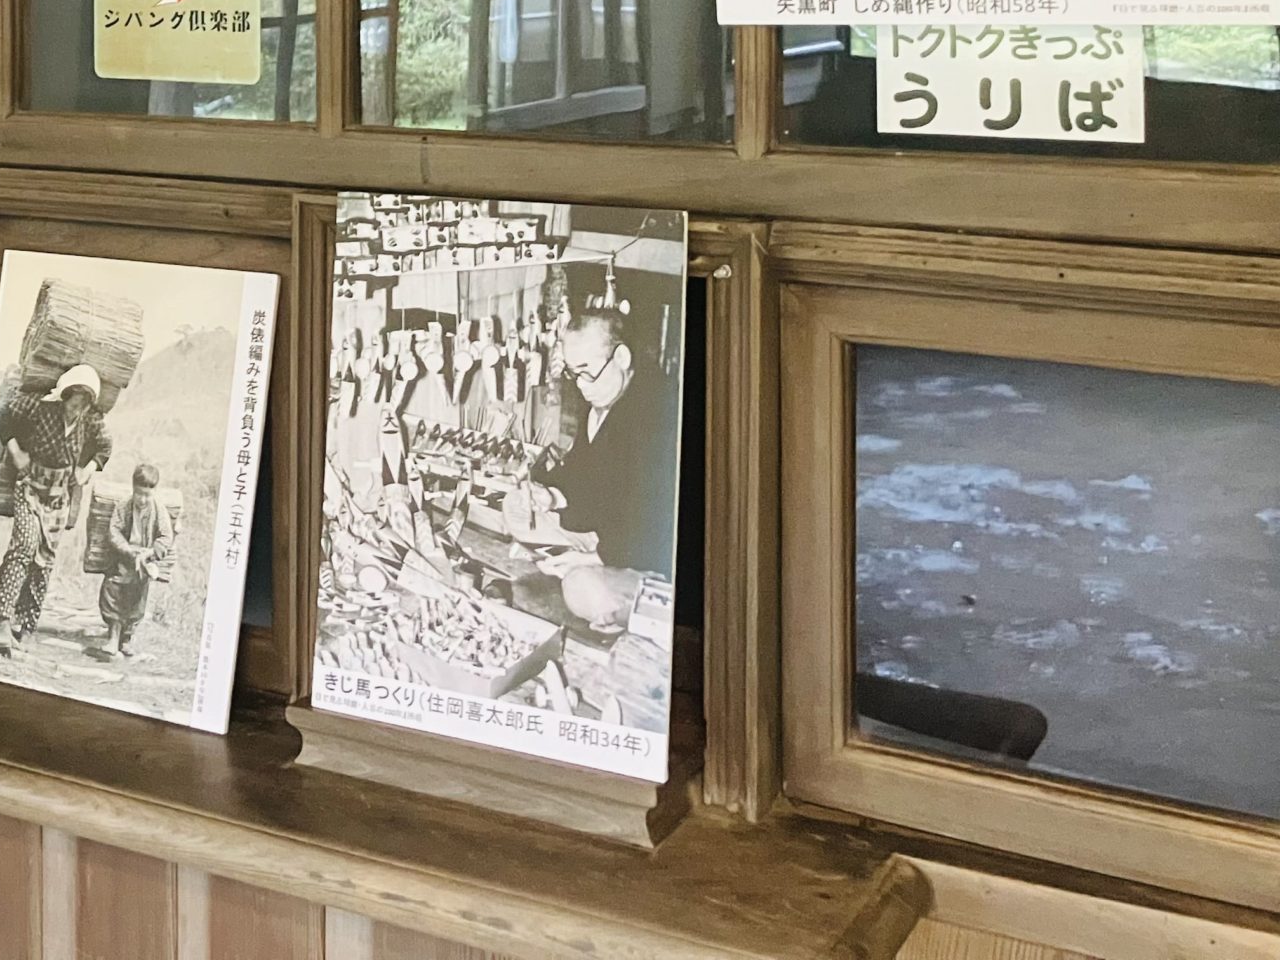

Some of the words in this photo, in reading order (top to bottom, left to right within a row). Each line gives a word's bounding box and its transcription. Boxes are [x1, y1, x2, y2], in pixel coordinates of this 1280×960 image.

[104, 9, 251, 33] ジパング倶楽部
[892, 25, 1125, 60] トクトクきっぷ
[893, 71, 1124, 132] うりば
[223, 309, 267, 570] 炭俵編みを背負う母と子（五木村）
